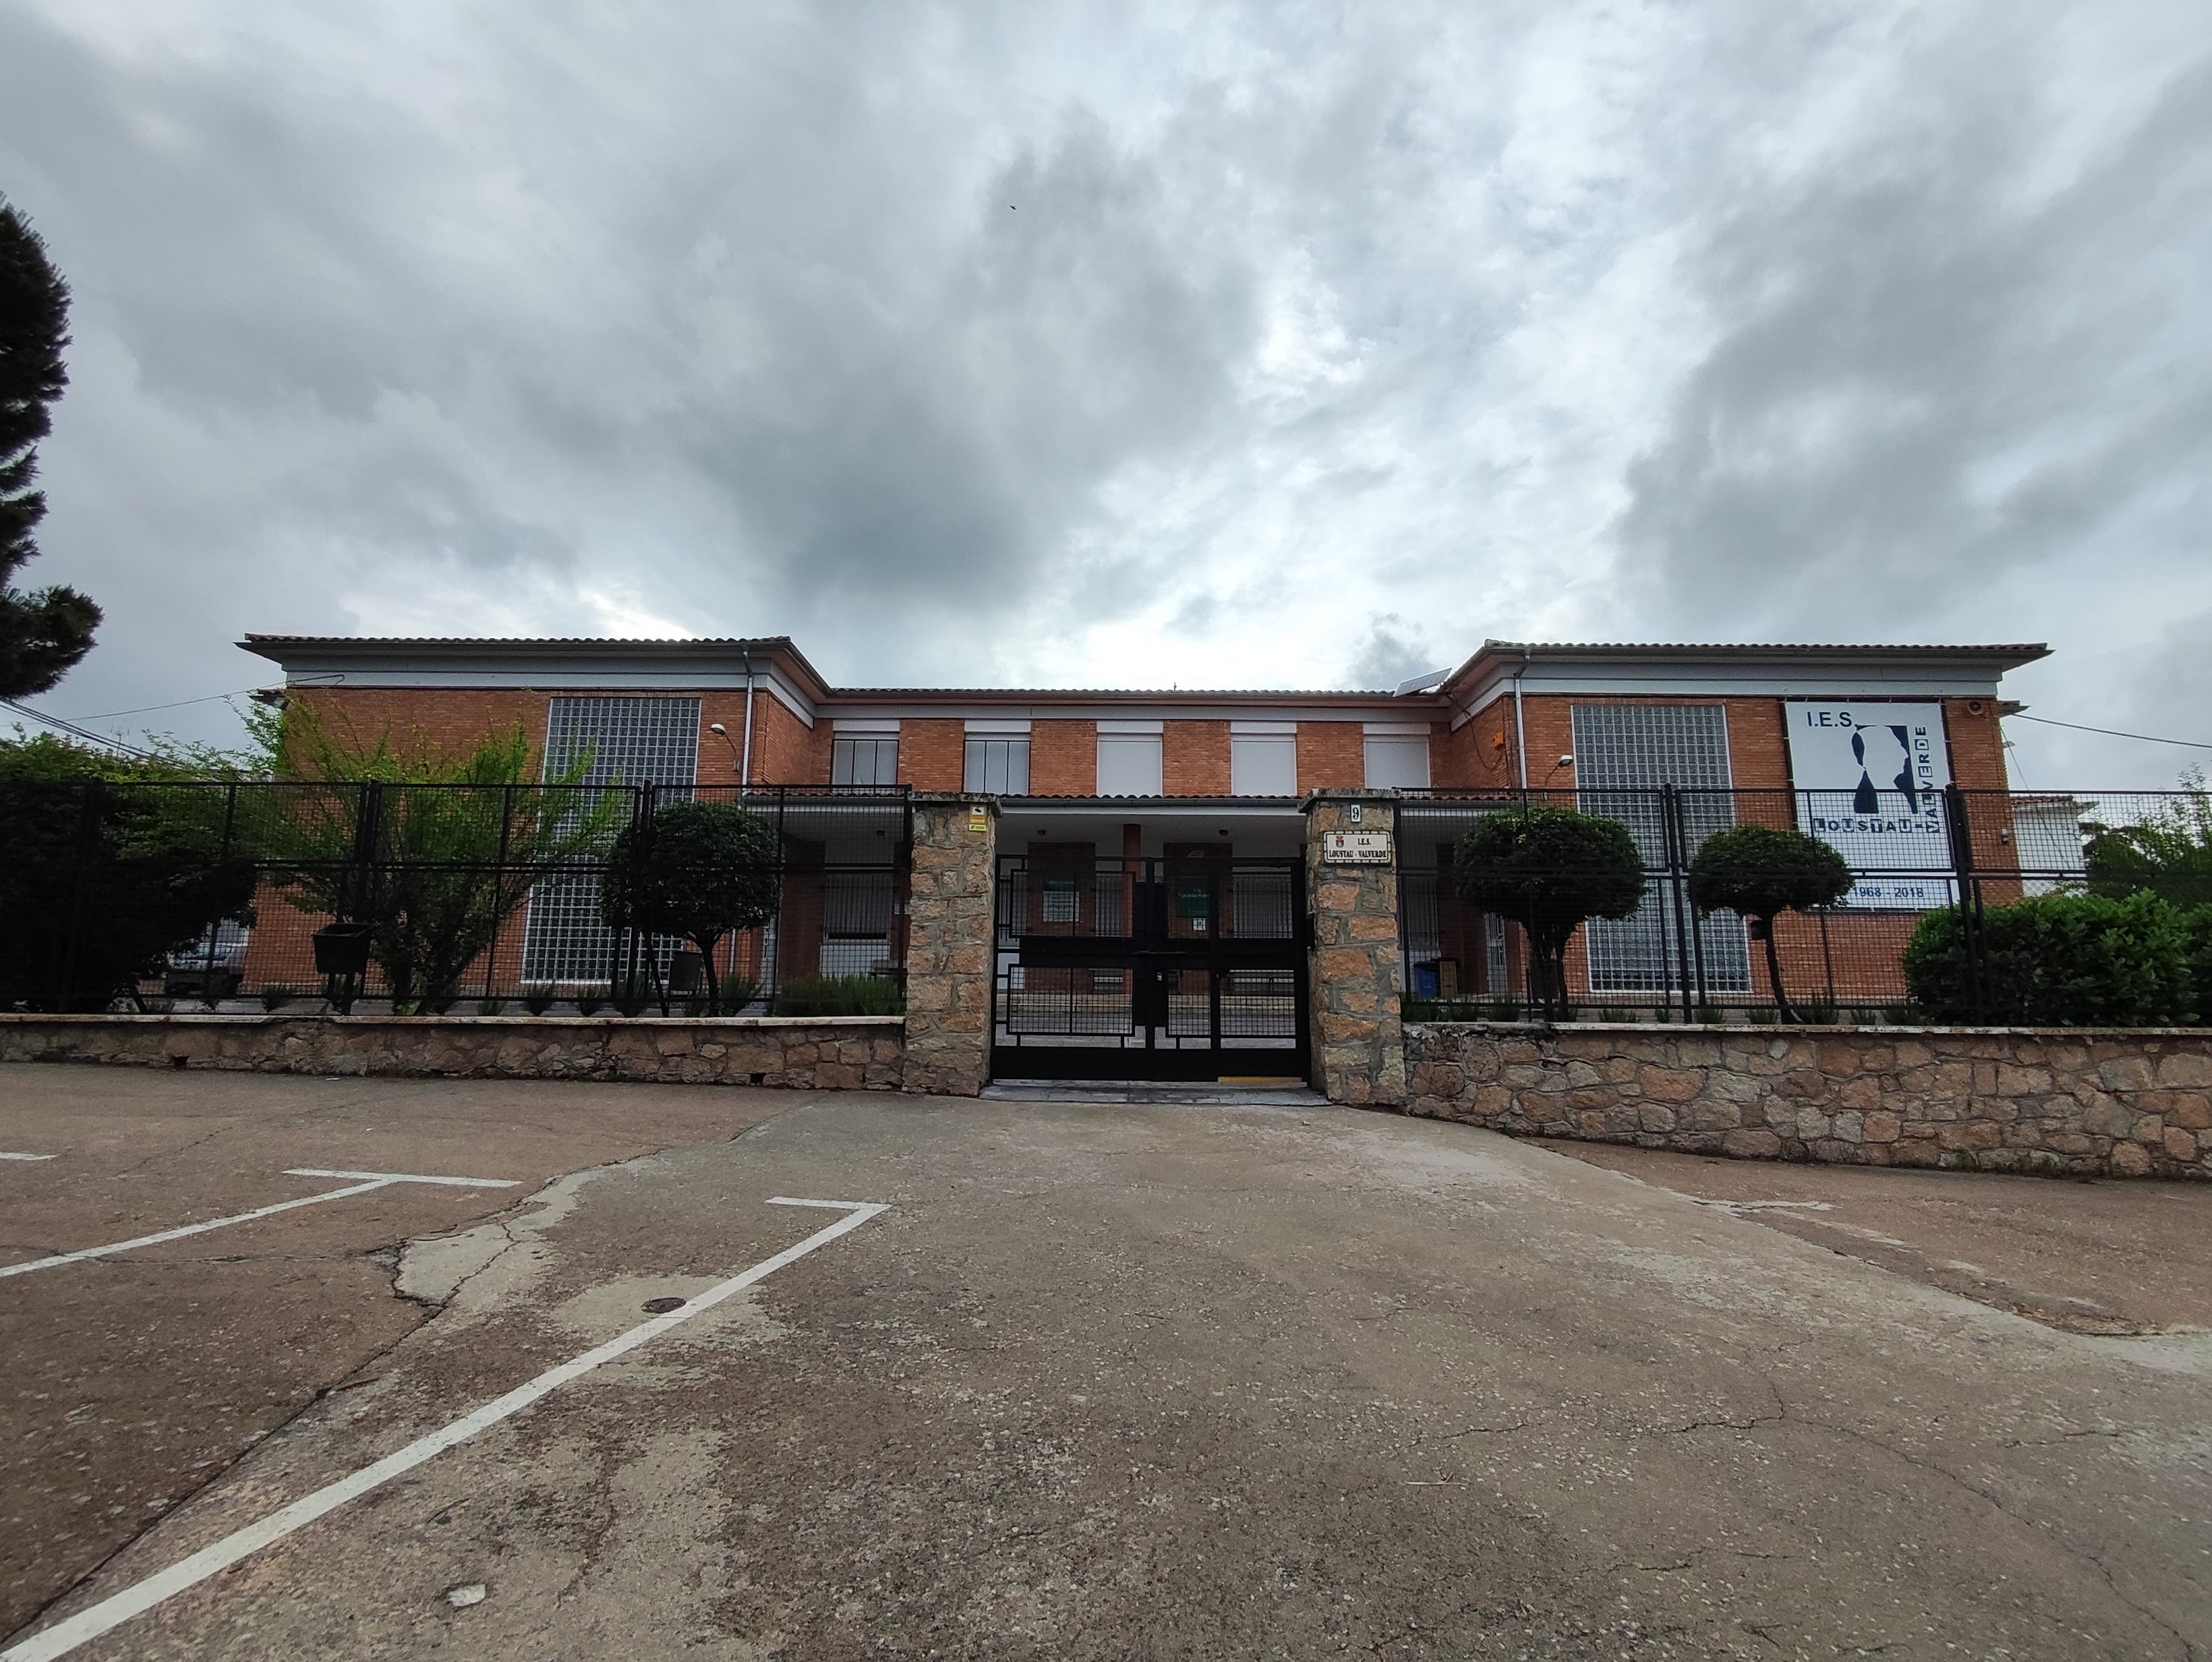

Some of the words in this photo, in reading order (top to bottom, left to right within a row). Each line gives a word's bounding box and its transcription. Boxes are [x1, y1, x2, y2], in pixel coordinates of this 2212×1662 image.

[1807, 712, 1858, 727] I.E.S.
[1352, 807, 1360, 820] 9
[1358, 838, 1372, 846] I.E.S.
[1329, 850, 1354, 858] LOUSTAU
[1358, 850, 1387, 858] VALVERDE
[1853, 887, 1882, 897] 1968
[1894, 887, 1924, 898] 2018
